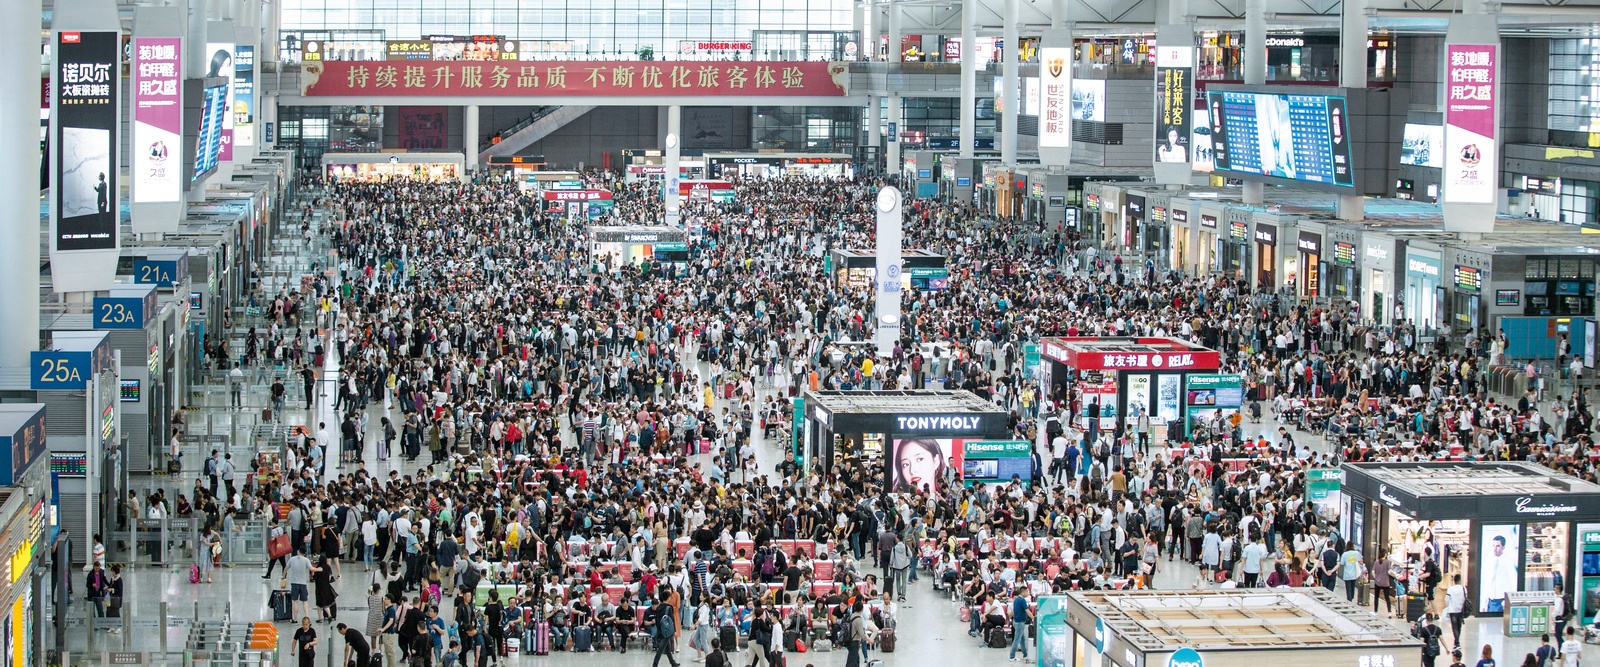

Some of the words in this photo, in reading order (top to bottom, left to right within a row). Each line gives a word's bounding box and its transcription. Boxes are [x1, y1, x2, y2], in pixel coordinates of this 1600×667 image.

[139, 45, 178, 60] 装地暖,
[698, 42, 730, 50] BURGER
[732, 42, 752, 50] KING
[1451, 52, 1493, 66] 装地暖,
[63, 63, 110, 82] 诺贝尔
[139, 63, 178, 77] 怕甲醛,
[347, 65, 568, 89] 持续提升服务品质
[583, 65, 805, 89] 不断优化旅客体验
[1451, 69, 1493, 83] 怕甲醛,
[139, 80, 177, 95] 用久盛
[1451, 85, 1492, 100] 用久盛
[1046, 84, 1058, 133] 世友地板
[141, 265, 170, 282] 21A
[101, 303, 135, 323] 23A
[1103, 354, 1148, 367] 旅友书屋
[1168, 354, 1192, 368] RELAY
[40, 358, 82, 382] 25A
[897, 416, 981, 430] TONYMOLY
[966, 443, 1004, 451] Hisense
[1515, 497, 1578, 513] Camicissima
